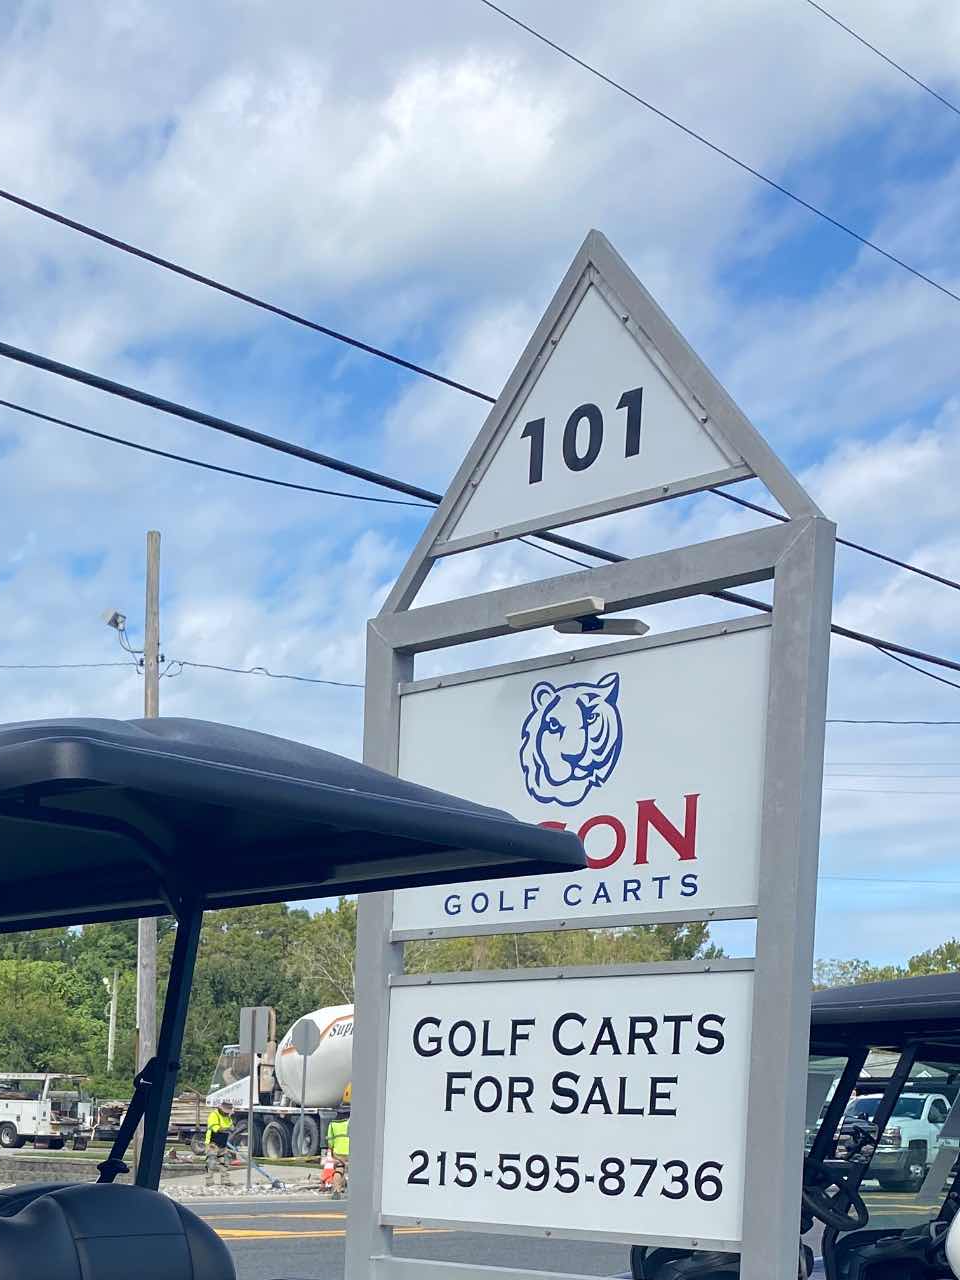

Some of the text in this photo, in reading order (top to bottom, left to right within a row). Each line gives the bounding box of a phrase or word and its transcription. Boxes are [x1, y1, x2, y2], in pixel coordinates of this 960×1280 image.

[520, 386, 644, 485] 101
[444, 873, 699, 916] GOLF CARTS
[412, 1012, 726, 1058] GOLF CARTS
[444, 1070, 679, 1117] FOR SALE
[407, 1149, 724, 1202] 215-595-8736
